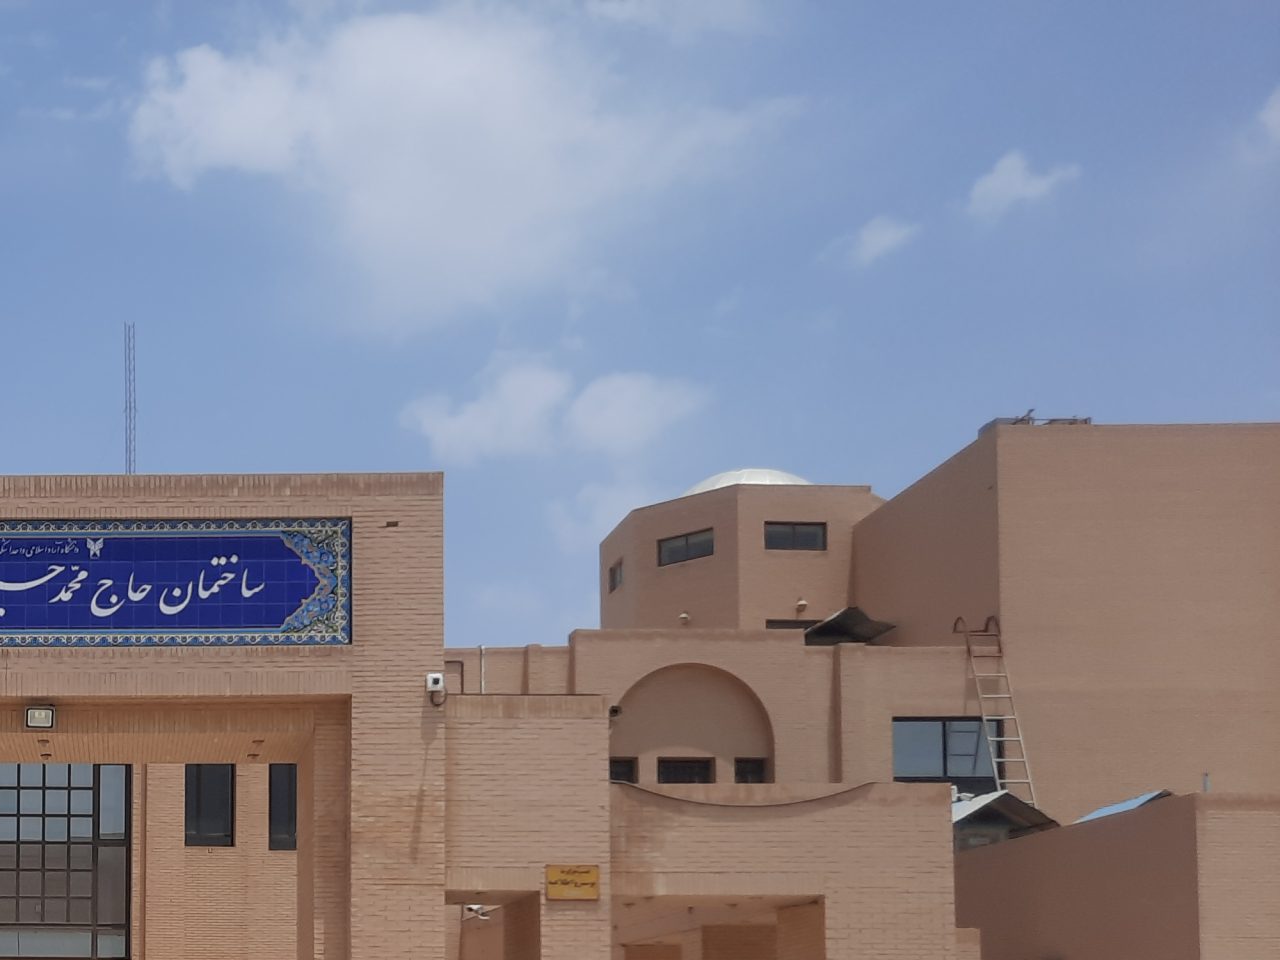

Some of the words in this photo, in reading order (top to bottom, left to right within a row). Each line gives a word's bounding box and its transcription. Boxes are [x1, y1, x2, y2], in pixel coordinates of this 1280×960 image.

[25, 545, 47, 558] اسلامی
[59, 537, 80, 555] دانشگاه
[90, 571, 153, 618] حاج
[159, 554, 266, 616] ساختمان
